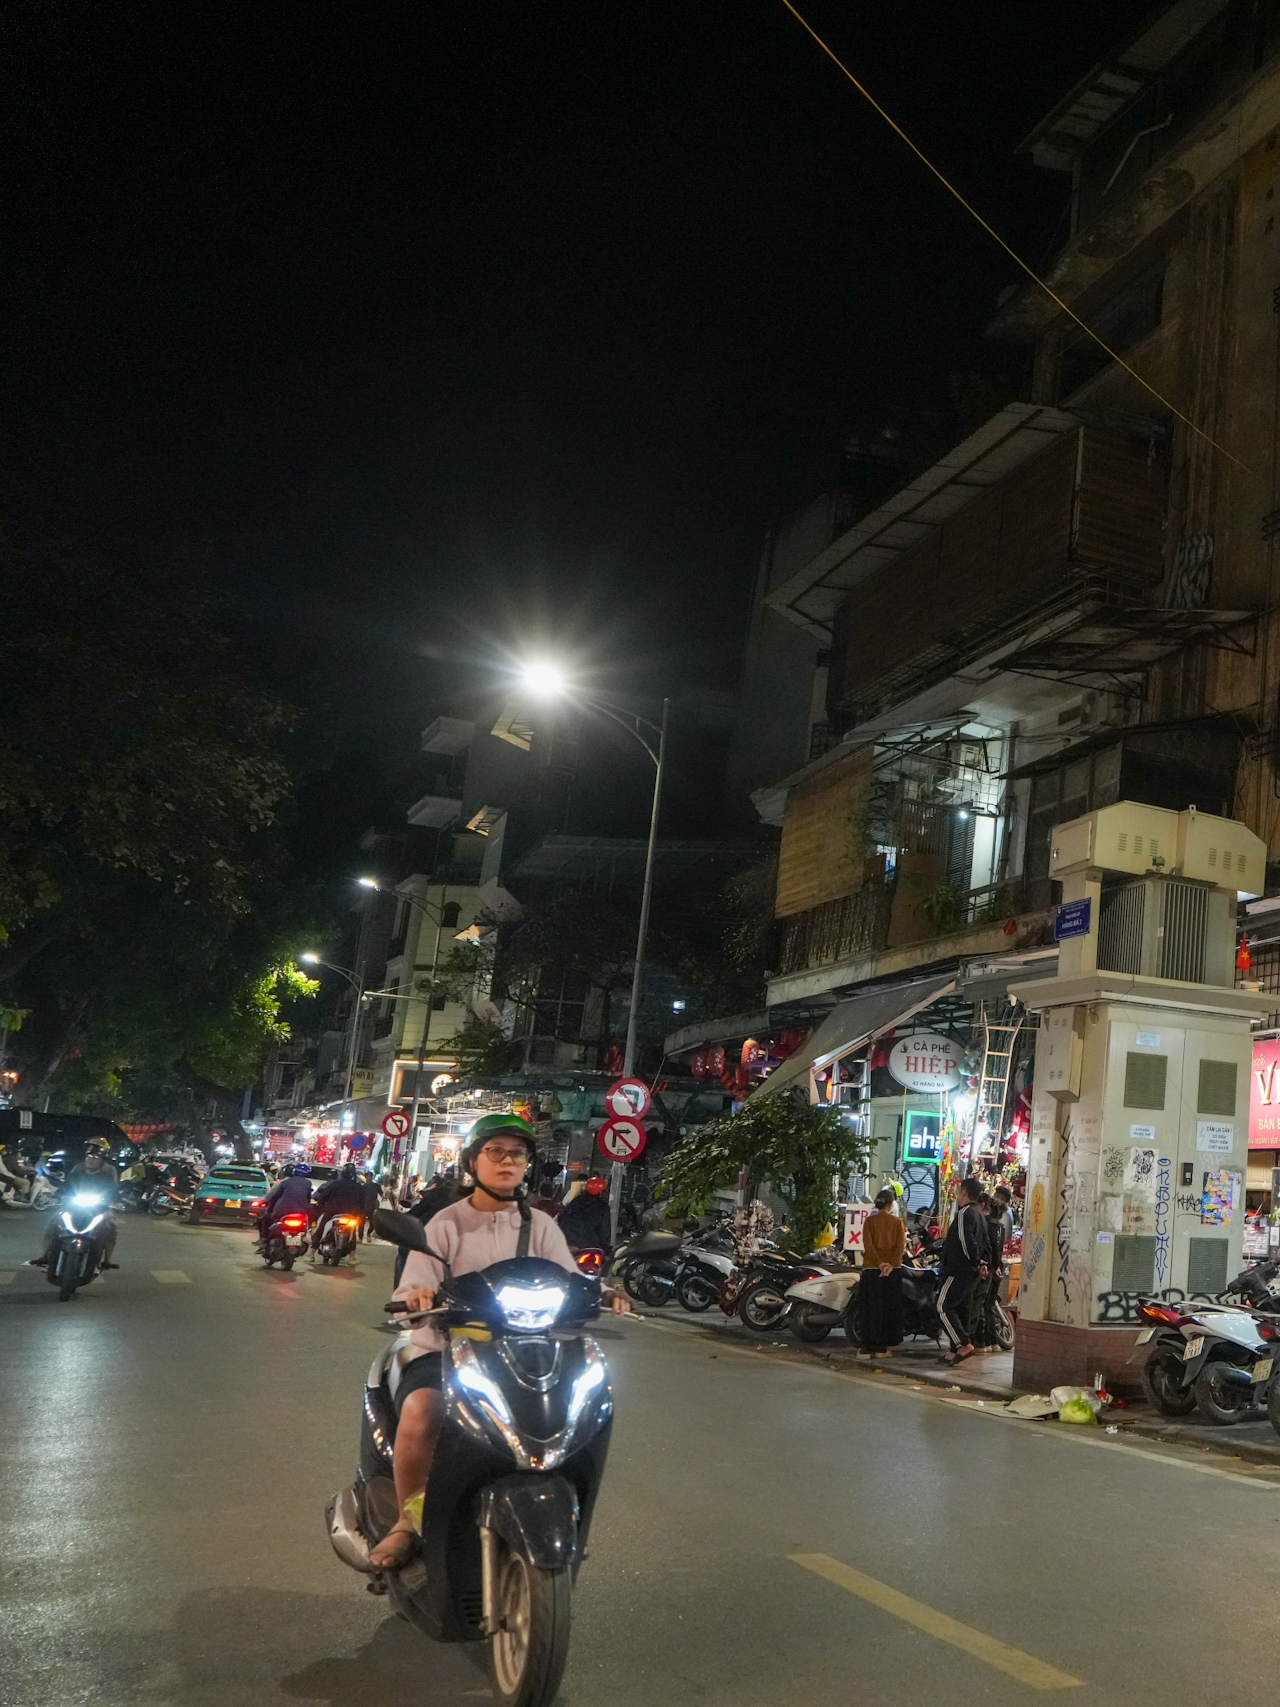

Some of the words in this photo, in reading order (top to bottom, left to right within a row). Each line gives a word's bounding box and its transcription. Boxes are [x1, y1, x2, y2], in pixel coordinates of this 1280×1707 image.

[913, 1040, 928, 1052] CÀ
[931, 1043, 952, 1053] PHÊ
[905, 1055, 957, 1078] HIỆP
[1258, 1114, 1275, 1130] BÁN
